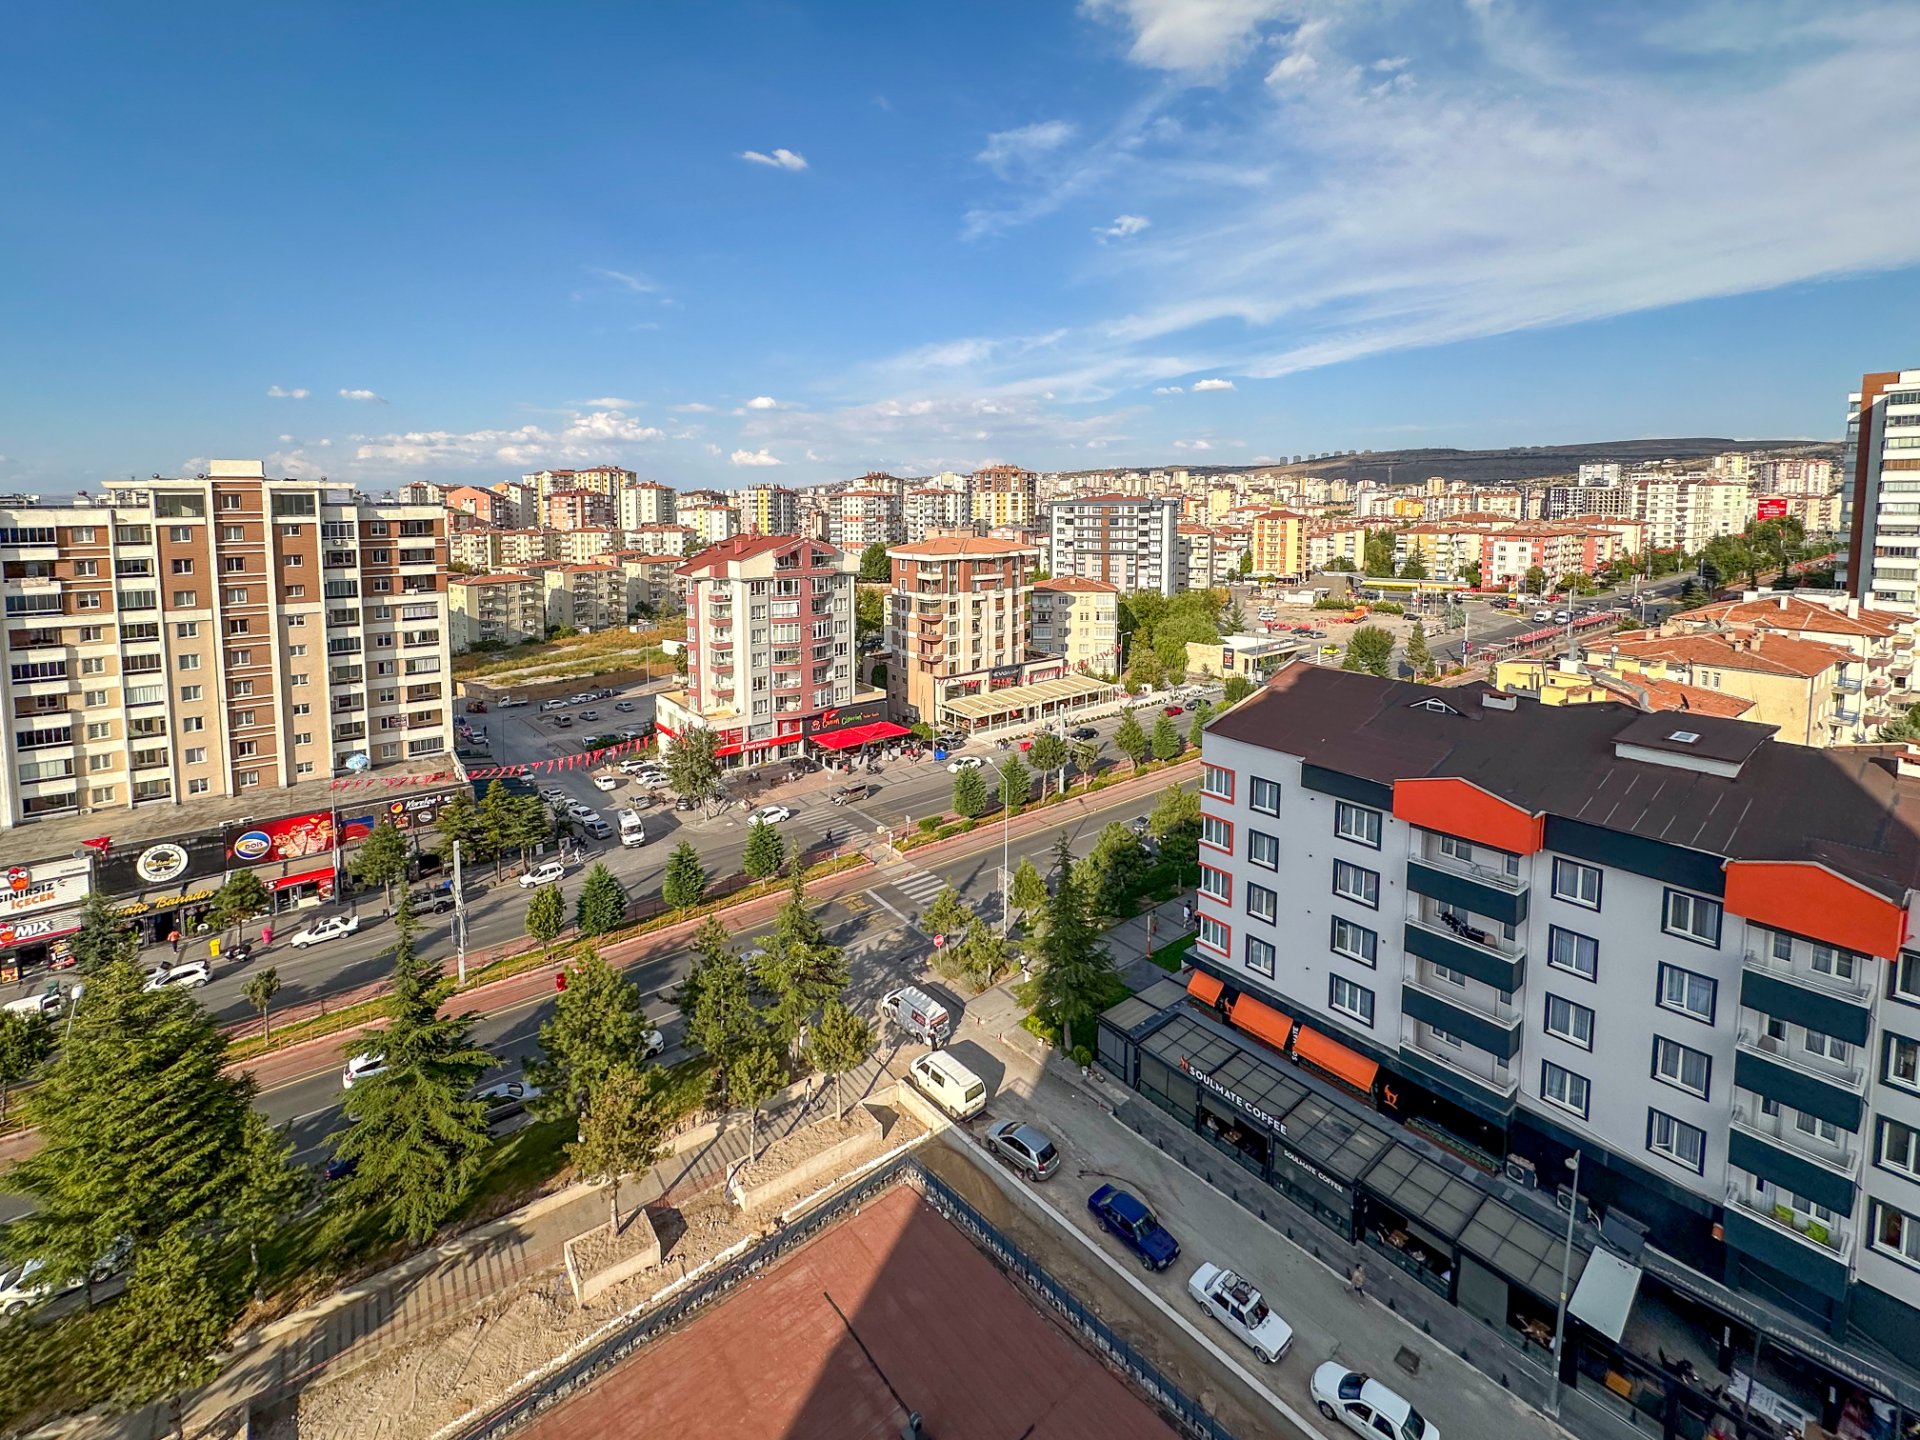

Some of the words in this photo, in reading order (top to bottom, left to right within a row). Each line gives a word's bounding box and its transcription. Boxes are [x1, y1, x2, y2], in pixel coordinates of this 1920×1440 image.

[14, 920, 52, 938] MIX
[1189, 1066, 1243, 1107] SOULMATE
[1245, 1102, 1288, 1135] COFFEE
[1318, 1172, 1343, 1193] COFFEE
